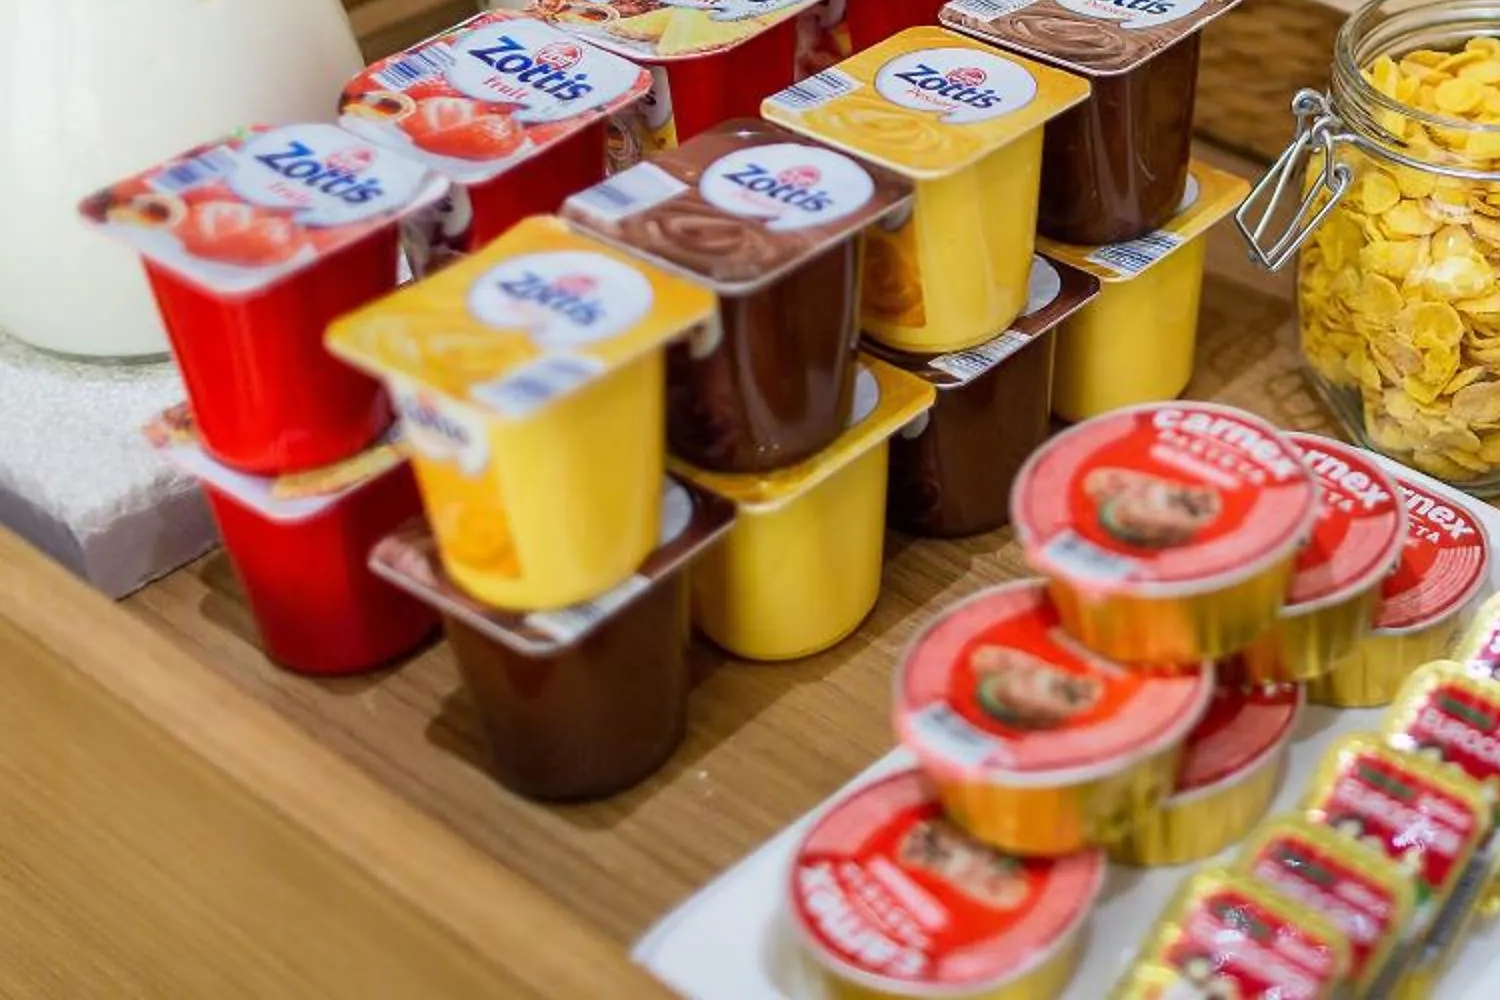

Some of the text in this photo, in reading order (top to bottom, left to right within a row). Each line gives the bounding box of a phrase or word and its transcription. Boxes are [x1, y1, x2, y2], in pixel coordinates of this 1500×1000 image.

[467, 36, 592, 100] Zottis
[893, 63, 1002, 108] Zottis
[255, 140, 383, 204] Zottis
[722, 163, 834, 213] Zottis
